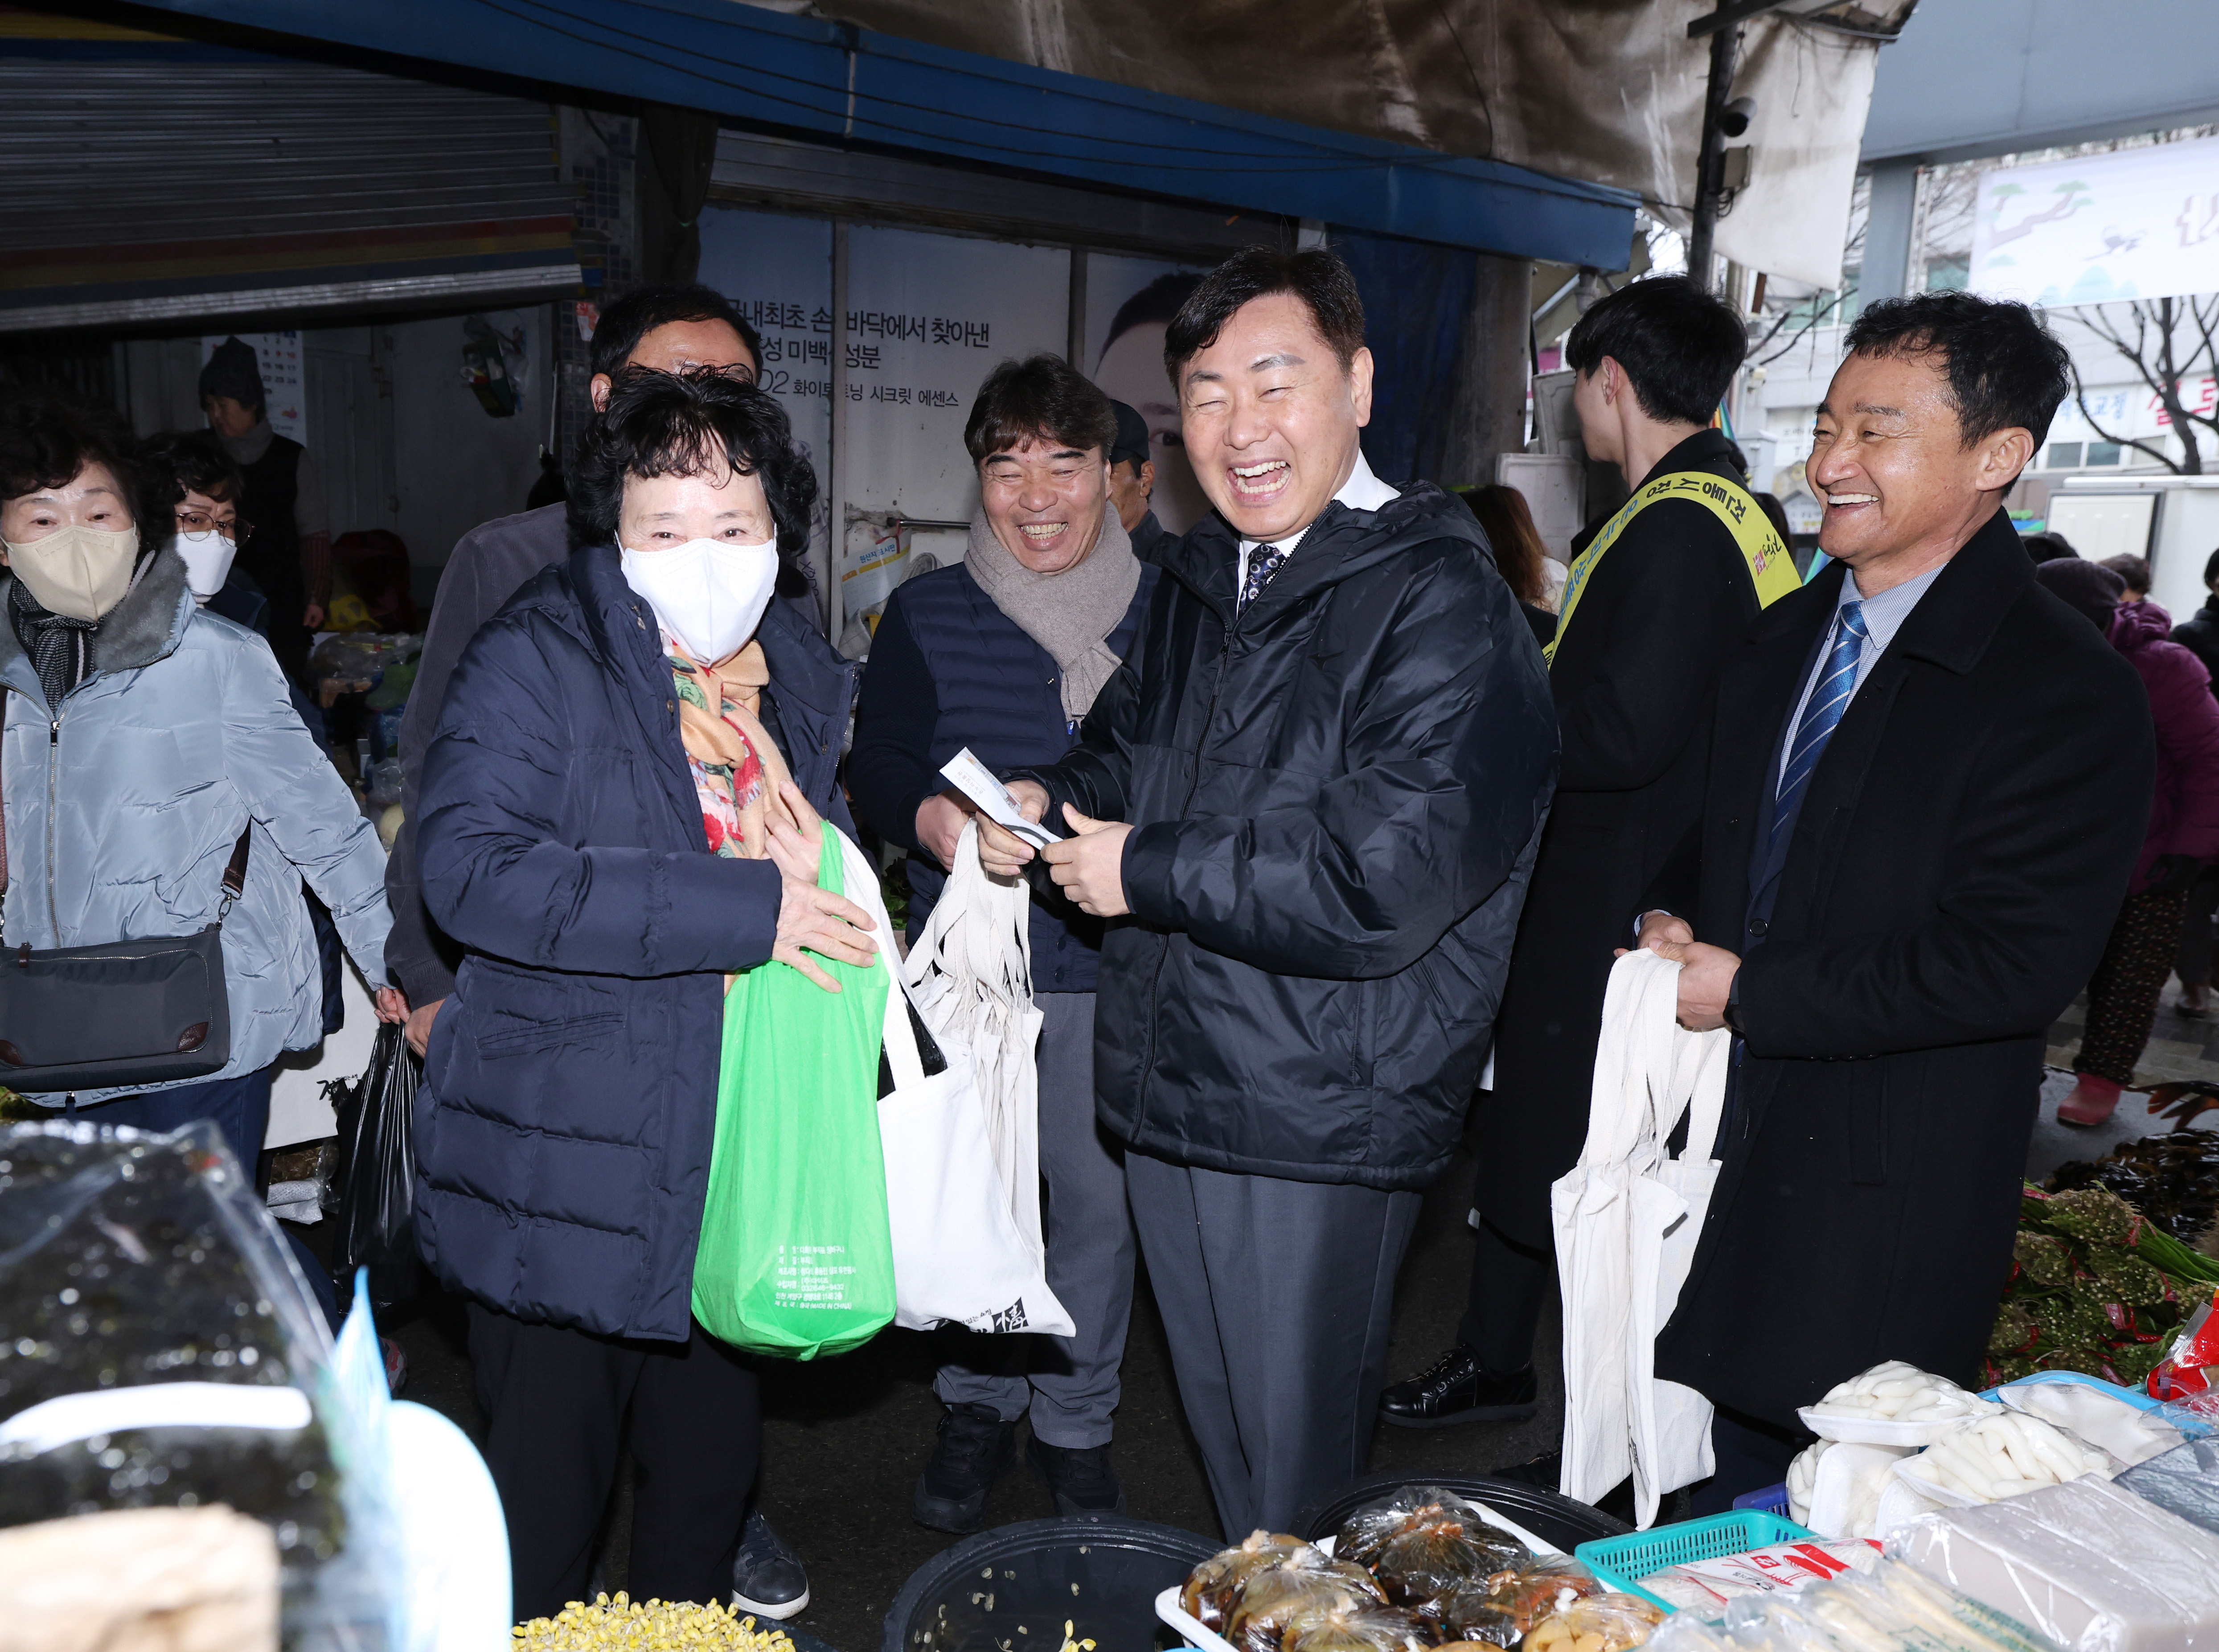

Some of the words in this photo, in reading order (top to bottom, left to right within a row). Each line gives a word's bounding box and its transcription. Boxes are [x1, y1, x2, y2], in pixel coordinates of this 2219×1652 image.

[931, 318, 989, 348] 찾아낸
[870, 385, 911, 405] 시크릿
[919, 389, 959, 407] 에센스
[1646, 477, 1747, 525] 전통시장
[859, 551, 877, 564] 원산지
[966, 1316, 979, 1324] 있는
[980, 1308, 992, 1317] 쇼핑
